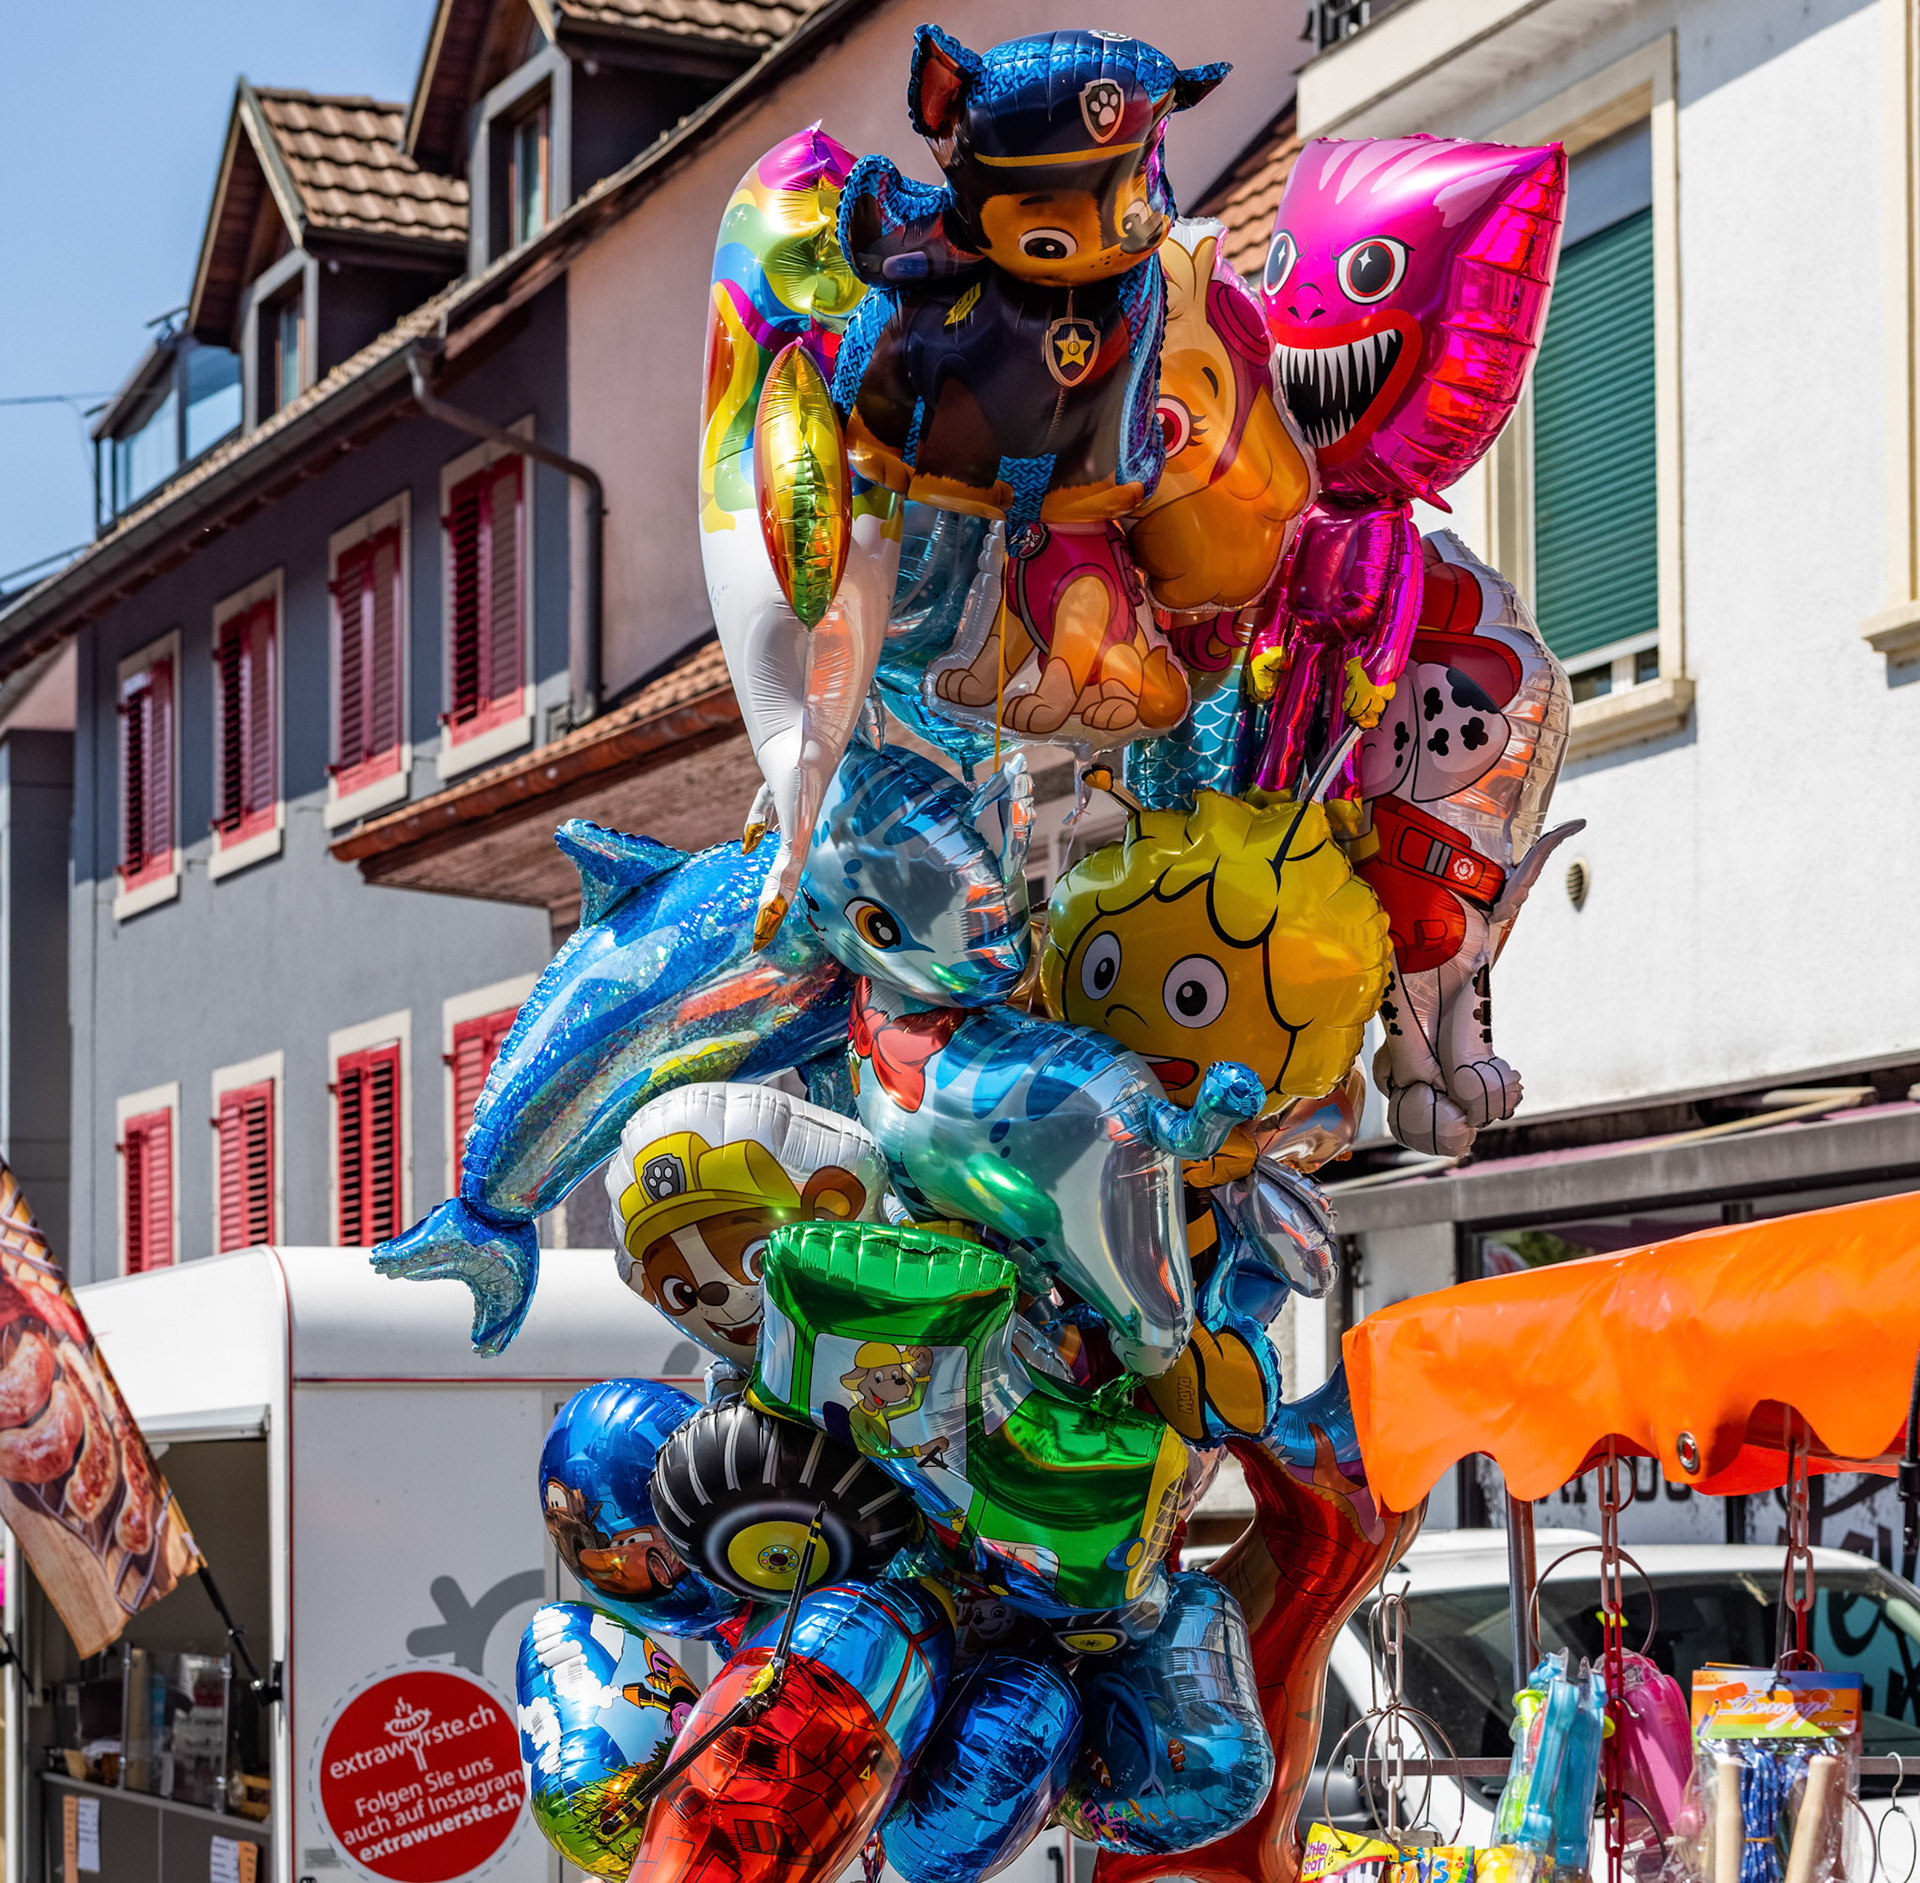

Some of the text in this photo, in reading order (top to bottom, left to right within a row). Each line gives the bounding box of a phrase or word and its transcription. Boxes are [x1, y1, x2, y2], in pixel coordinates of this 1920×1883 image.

[1177, 1376, 1195, 1415] Maya
[343, 1769, 524, 1846] auch auf Instagram
[355, 1757, 494, 1818] Folgen Sie uns
[359, 1790, 522, 1862] extrawuerste.ch
